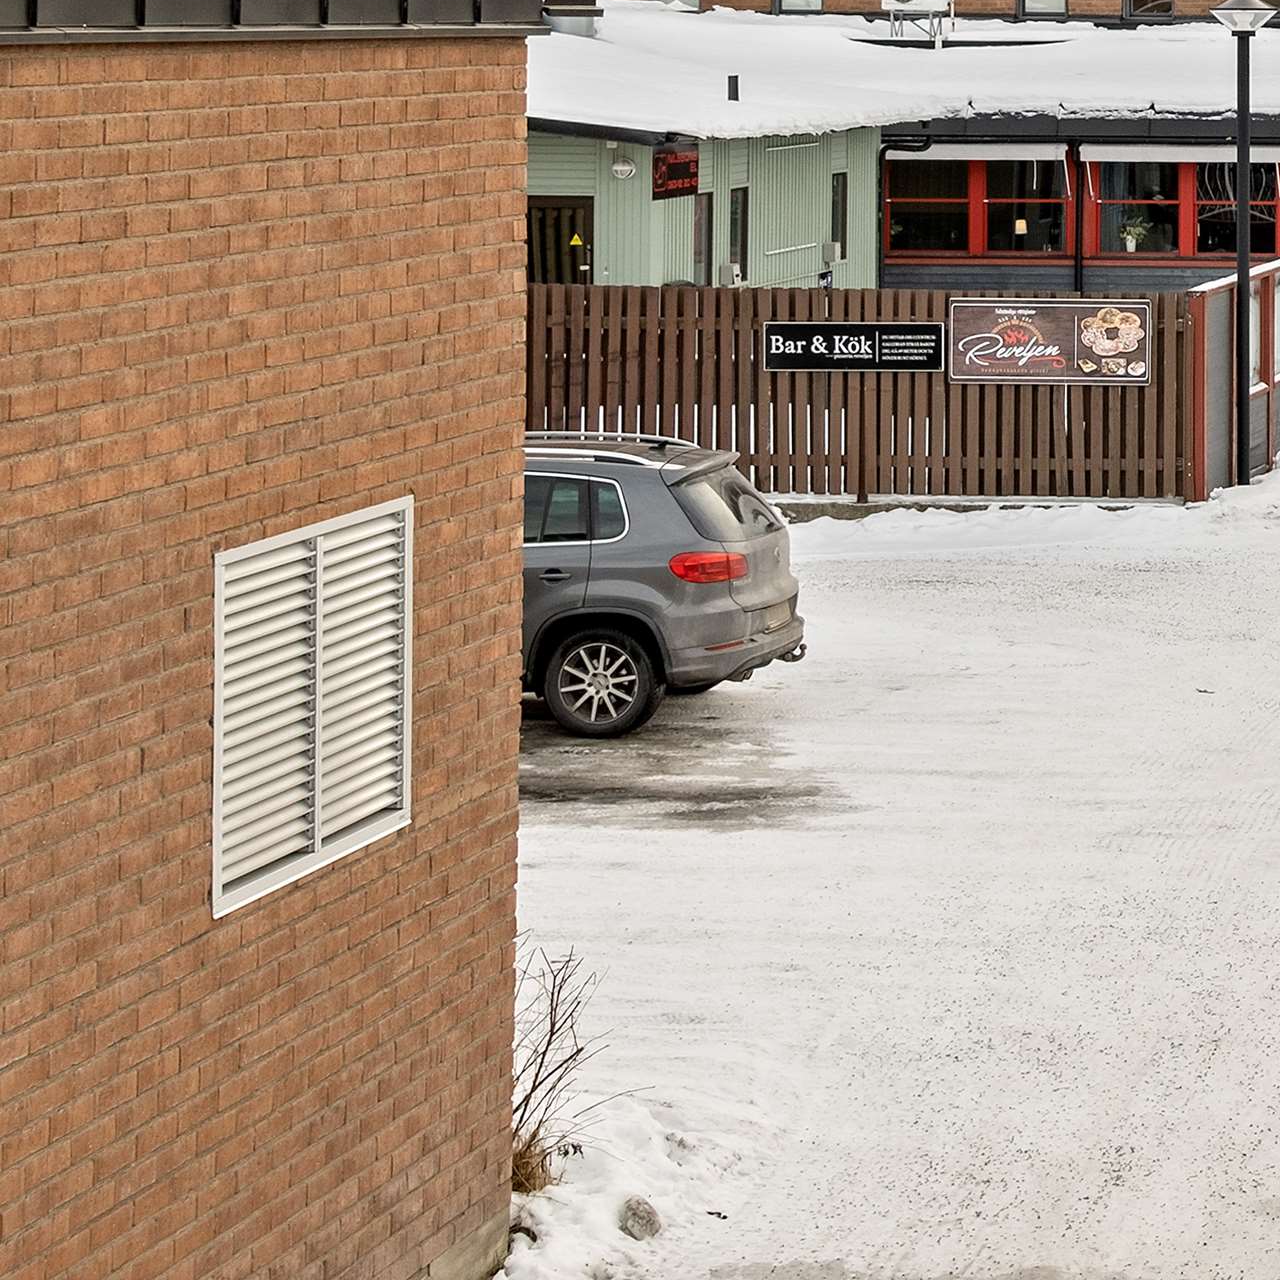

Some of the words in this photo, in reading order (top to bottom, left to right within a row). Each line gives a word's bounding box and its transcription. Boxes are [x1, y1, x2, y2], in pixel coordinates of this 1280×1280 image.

[769, 335, 807, 354] Bar
[810, 335, 829, 354] &
[832, 335, 873, 354] Kök
[958, 333, 1061, 366] Reveljen
